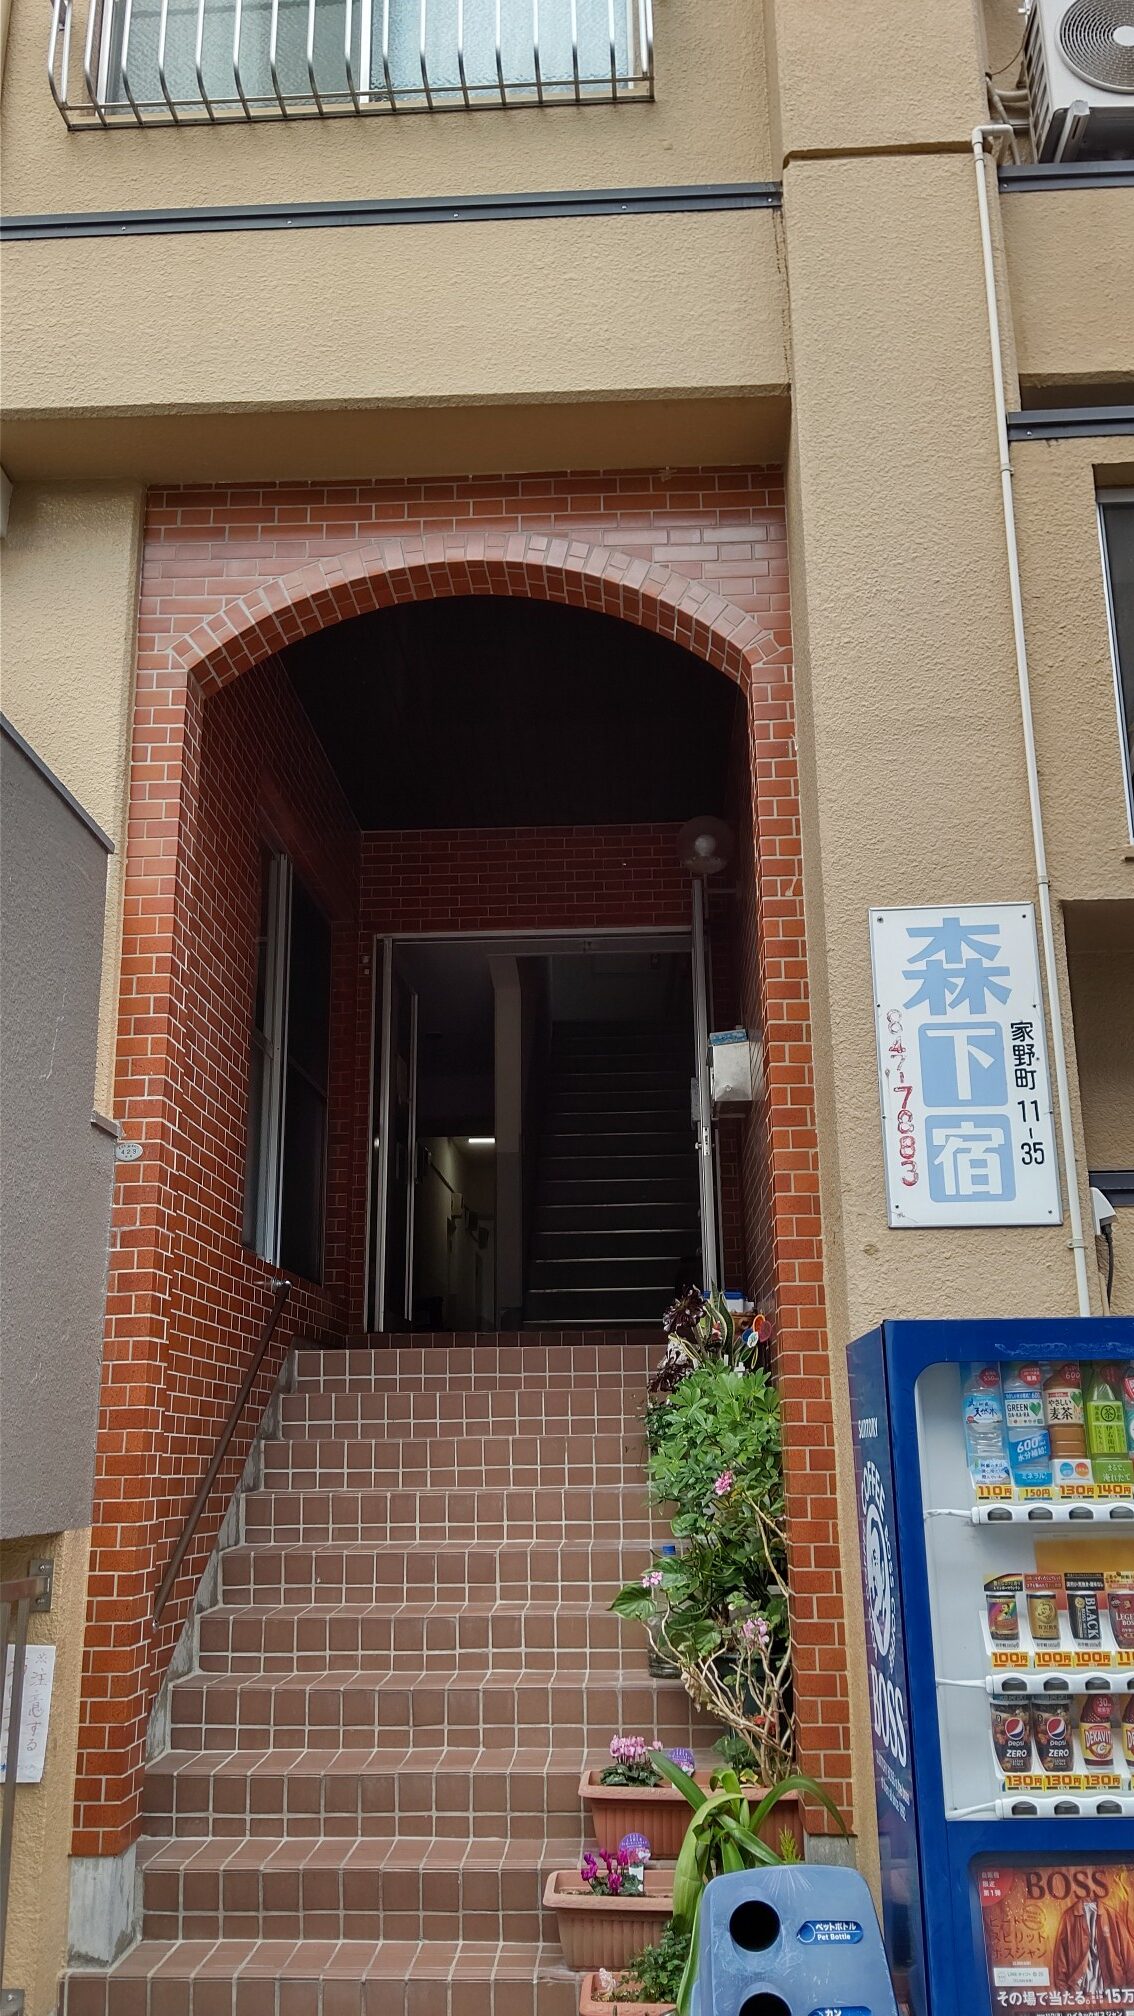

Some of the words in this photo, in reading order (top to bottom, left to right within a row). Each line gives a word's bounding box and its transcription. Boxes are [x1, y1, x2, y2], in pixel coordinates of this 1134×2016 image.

[902, 917, 1012, 1196] 森下宿
[1007, 1403, 1029, 1412] GREEN
[1049, 1406, 1073, 1420] 麦茶
[861, 1460, 886, 1522] COFFEE
[978, 1486, 1012, 1496] 110円
[1025, 1488, 1051, 1498] 150円
[1060, 1485, 1095, 1496] 130円
[1097, 1484, 1132, 1495] 140円
[1084, 1597, 1100, 1639] BLACK
[1116, 1612, 1134, 1620] LEGE
[992, 1653, 1028, 1664] 100円
[1035, 1653, 1072, 1663] 100円
[1075, 1652, 1111, 1663] 100円
[1117, 1652, 1134, 1662] 11
[871, 1664, 906, 1768] BOSS
[1085, 1730, 1112, 1746] DEKAVIT
[1006, 1749, 1028, 1758] ZERO
[1048, 1749, 1070, 1758] ZERO
[1006, 1775, 1042, 1786] 130円
[1045, 1775, 1081, 1786] 130円
[1084, 1775, 1120, 1786] 130円
[1026, 1870, 1110, 1901] BOSS
[983, 1889, 1001, 1897] 第1弾
[815, 1922, 857, 1931] ペットボトル
[997, 1990, 1091, 2006] その場で当たる。
